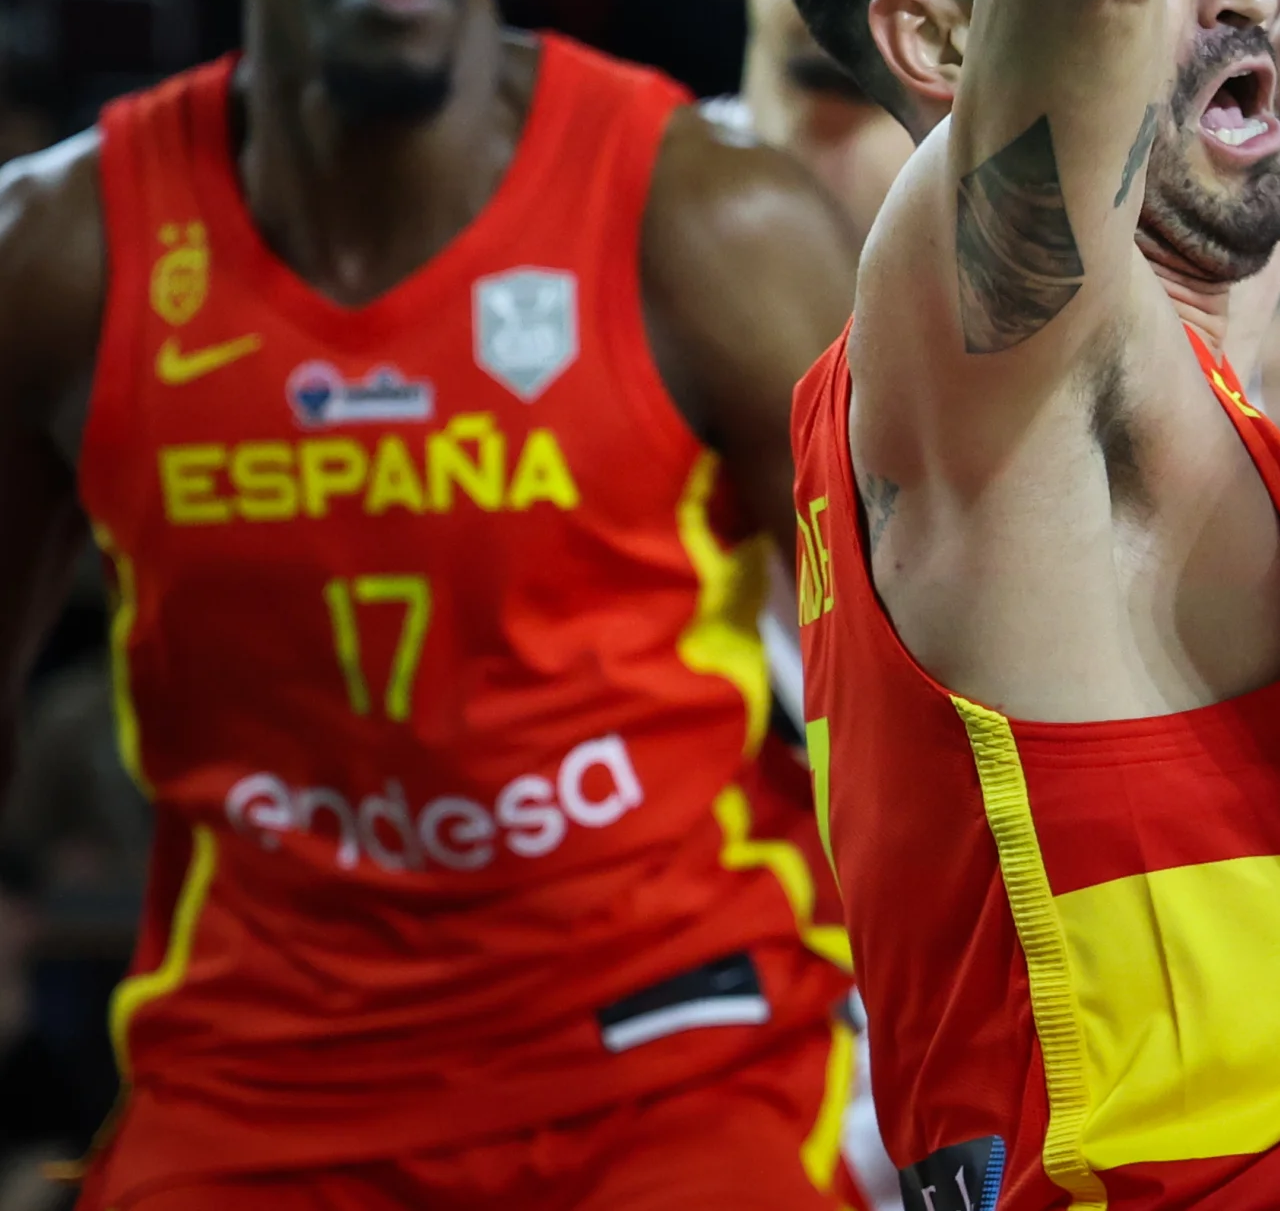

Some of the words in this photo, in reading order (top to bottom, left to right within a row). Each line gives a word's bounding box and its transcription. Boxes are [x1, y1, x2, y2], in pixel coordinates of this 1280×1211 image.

[158, 413, 580, 524] ESPAÑA
[324, 575, 431, 724] 17
[224, 733, 642, 873] endesa
